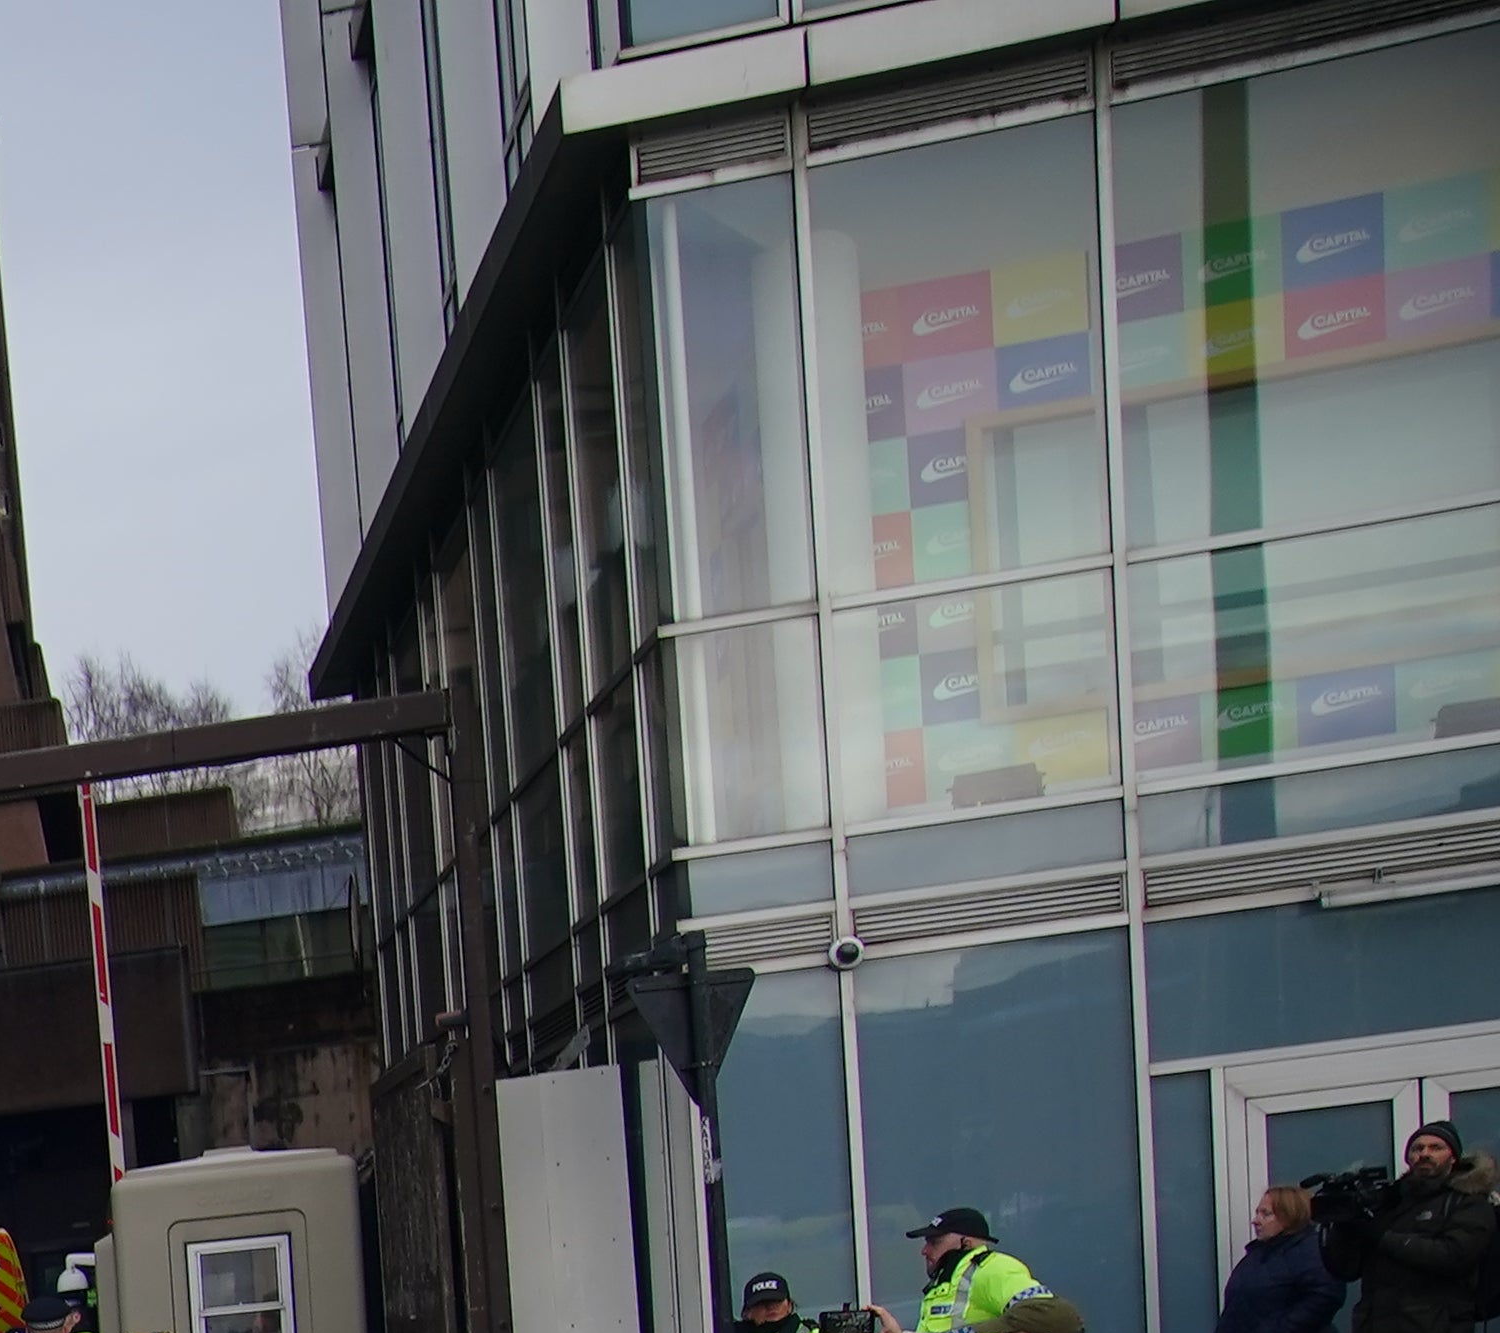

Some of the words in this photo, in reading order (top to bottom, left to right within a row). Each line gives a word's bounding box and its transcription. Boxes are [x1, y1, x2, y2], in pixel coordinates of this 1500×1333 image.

[1311, 227, 1370, 251] CAPITAL
[1115, 269, 1171, 291] CAPITAL
[1415, 285, 1475, 309] CAPITAL
[926, 304, 980, 325] CAPITAL
[1311, 306, 1372, 330] CAPITAL
[1024, 361, 1078, 382] CAPITAL
[930, 379, 983, 399] CAPITAL
[1327, 684, 1383, 706] CAPITAL
[1135, 713, 1189, 734] CAPITAL
[752, 1280, 777, 1292] POLICE
